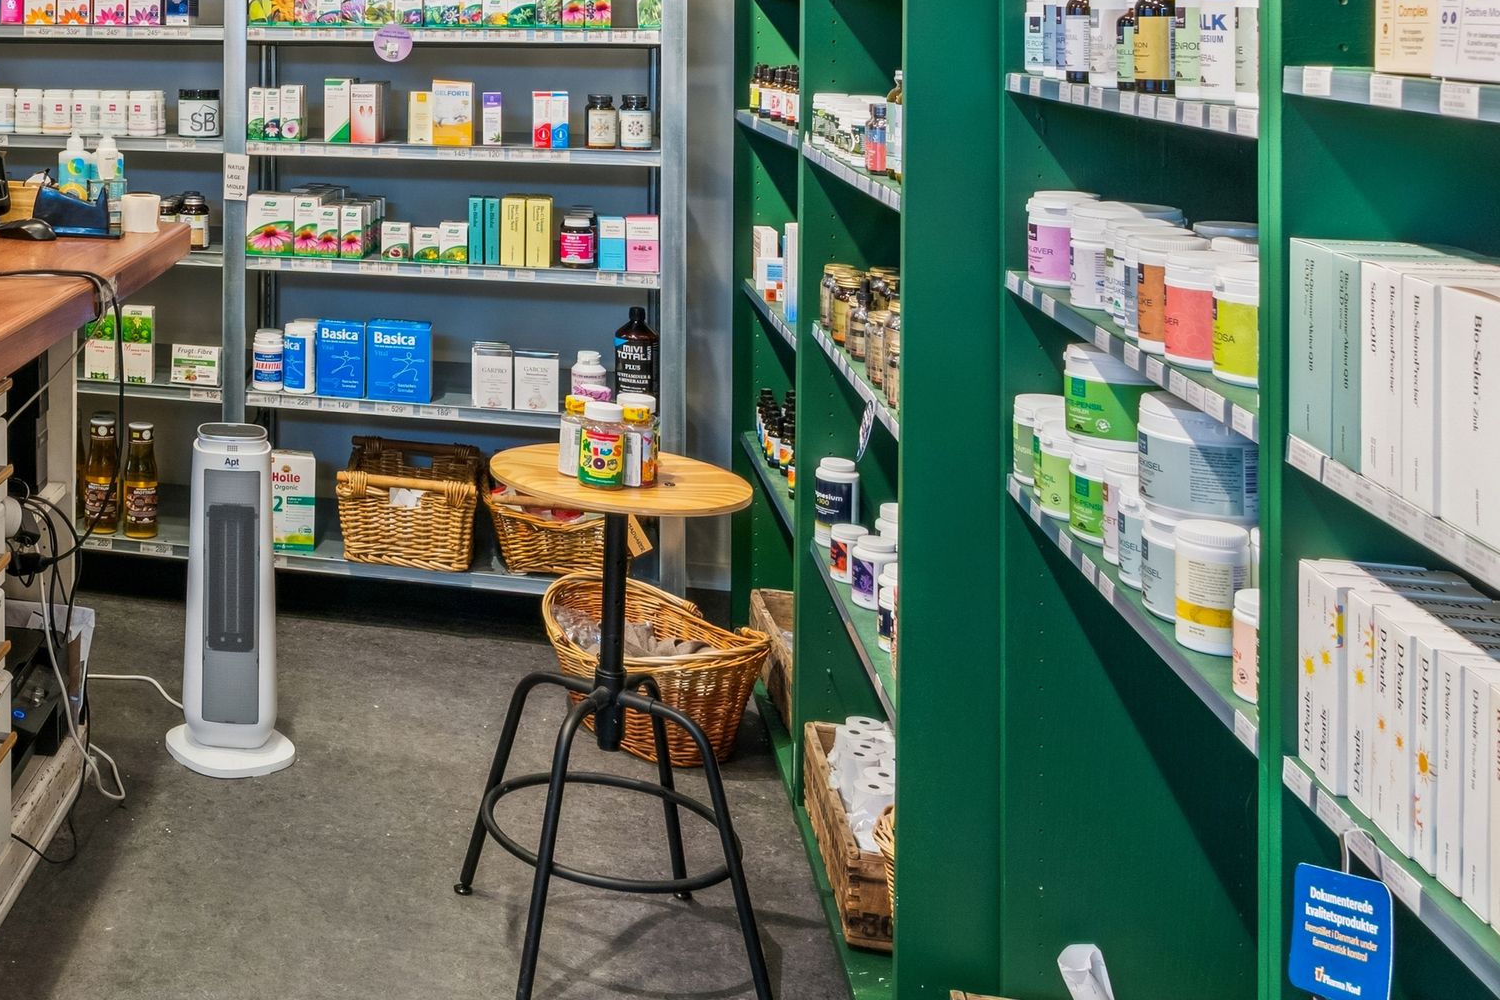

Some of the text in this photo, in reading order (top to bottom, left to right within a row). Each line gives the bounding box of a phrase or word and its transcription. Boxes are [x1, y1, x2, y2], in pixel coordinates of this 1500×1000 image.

[1398, 4, 1429, 19] Complex
[434, 90, 470, 98] GELFORTE
[189, 112, 217, 132] SB
[227, 173, 241, 181] LÆGE
[321, 327, 359, 341] Basica
[373, 331, 416, 345] Basica
[177, 346, 214, 356] Frugt Fibre
[284, 340, 301, 351] sica
[622, 344, 644, 354] MIVI
[616, 350, 647, 361] TOTAL
[624, 363, 641, 371] PLUS
[224, 457, 240, 467] Apt
[271, 471, 301, 483] Holle
[274, 483, 299, 491] Organic
[272, 495, 284, 513] 2
[1378, 628, 1388, 697] D-Pearls
[1397, 642, 1406, 713] D-Pearls
[1420, 656, 1430, 731] D-Pearls
[1304, 688, 1313, 752] D-Pearls
[1319, 705, 1328, 772] D-Pearls
[1353, 726, 1362, 795] D-Pearls
[1309, 886, 1374, 915] Dokumenterede
[1304, 901, 1379, 935] kvalitetsprodukter
[1334, 932, 1360, 947] Danmark
[1359, 939, 1378, 952] under
[1346, 948, 1369, 963] kontrol
[1345, 981, 1362, 996] Nord
